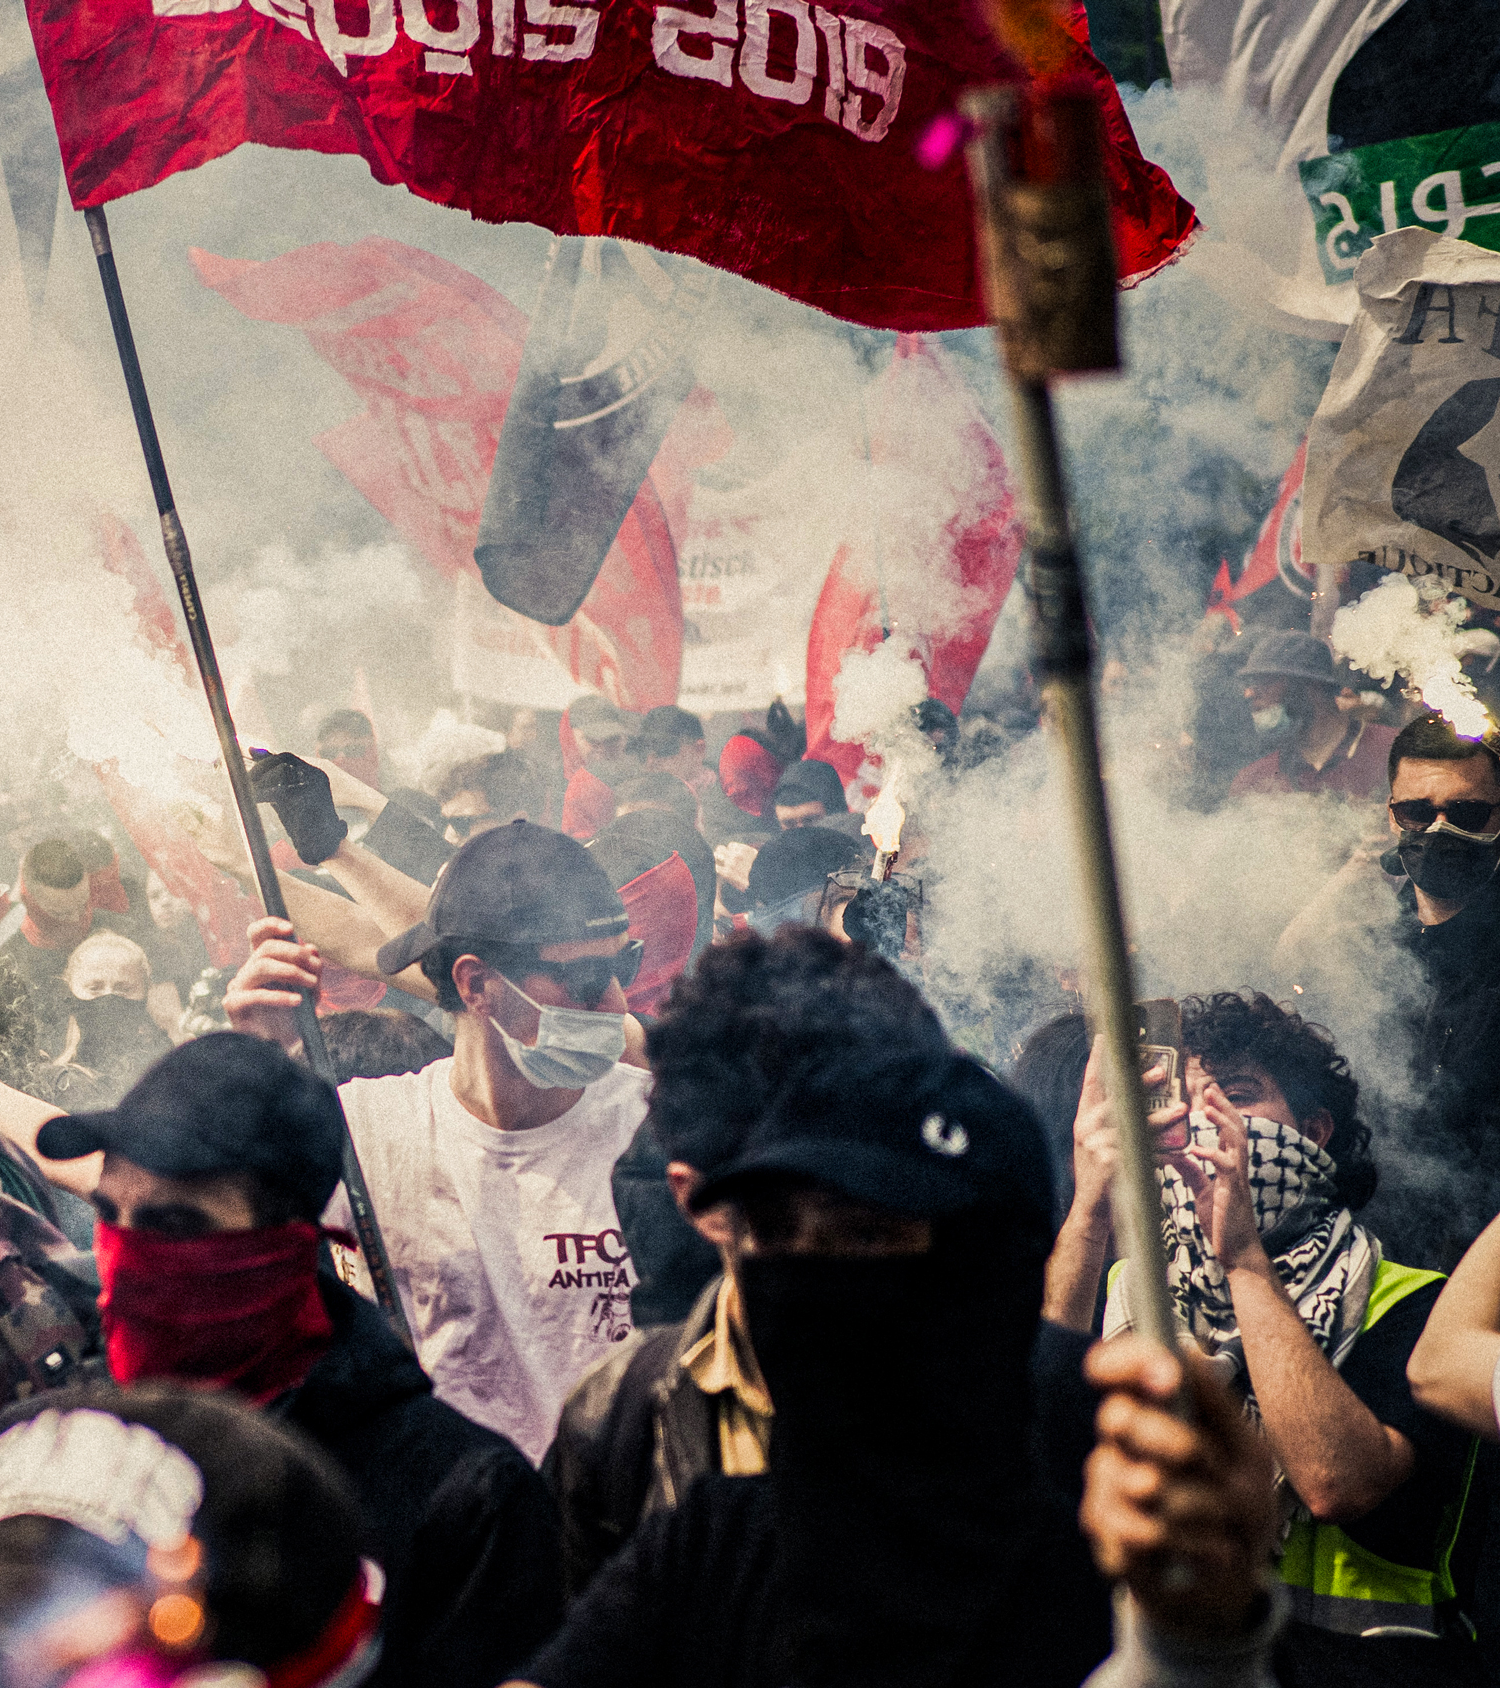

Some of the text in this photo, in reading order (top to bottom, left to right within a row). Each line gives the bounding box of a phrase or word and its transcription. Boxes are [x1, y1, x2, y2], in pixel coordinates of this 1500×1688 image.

[651, 0, 905, 142] 2019
[543, 1229, 632, 1266] TFC
[548, 1268, 631, 1289] ANTIFA
